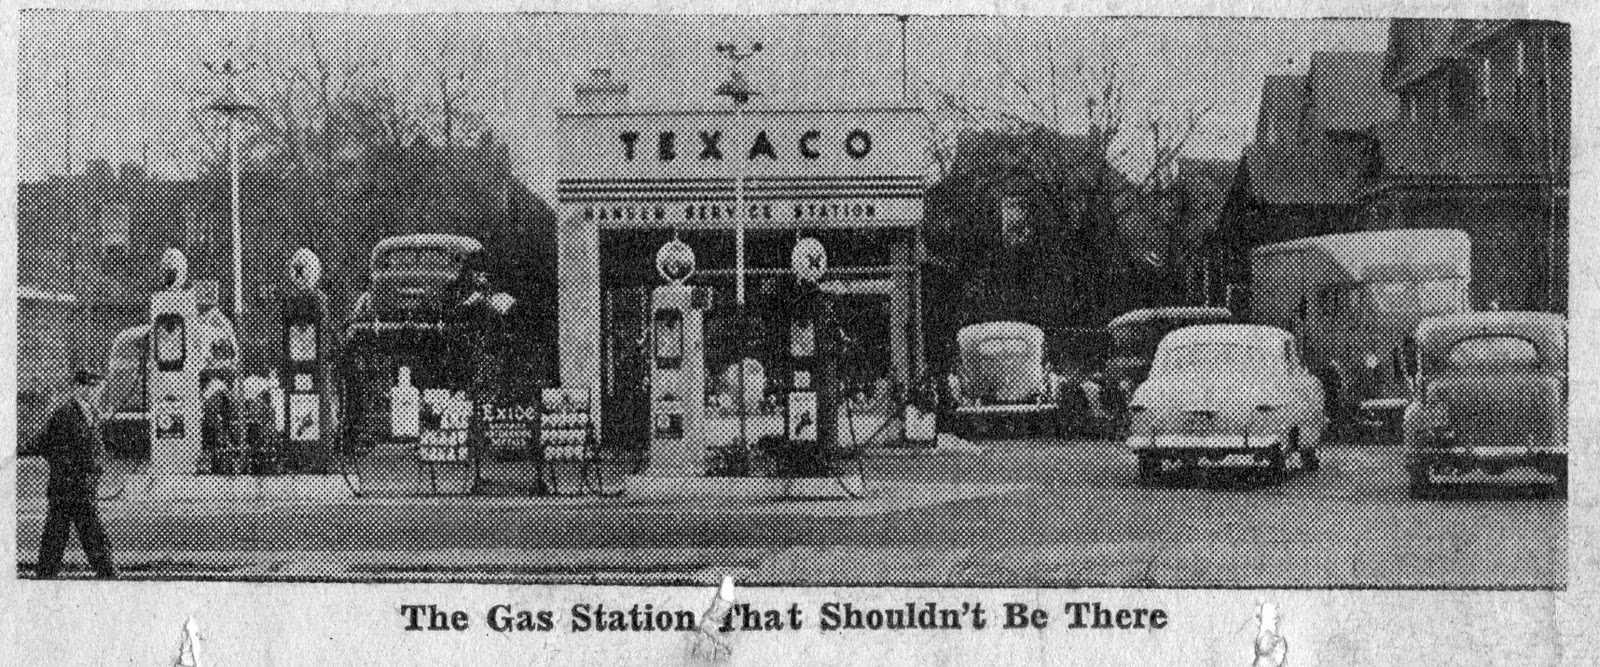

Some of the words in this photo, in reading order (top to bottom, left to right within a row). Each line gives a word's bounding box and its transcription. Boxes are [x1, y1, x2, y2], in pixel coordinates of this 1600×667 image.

[619, 129, 874, 162] TEXACO
[684, 203, 773, 219] SERVCE
[794, 201, 876, 218] STATION
[401, 605, 468, 630] The
[488, 605, 553, 631] Gas
[572, 604, 696, 632] Station
[718, 603, 802, 632] That
[820, 602, 985, 631] Shouldn't
[1004, 603, 1047, 628] Be
[1066, 602, 1167, 628] There
